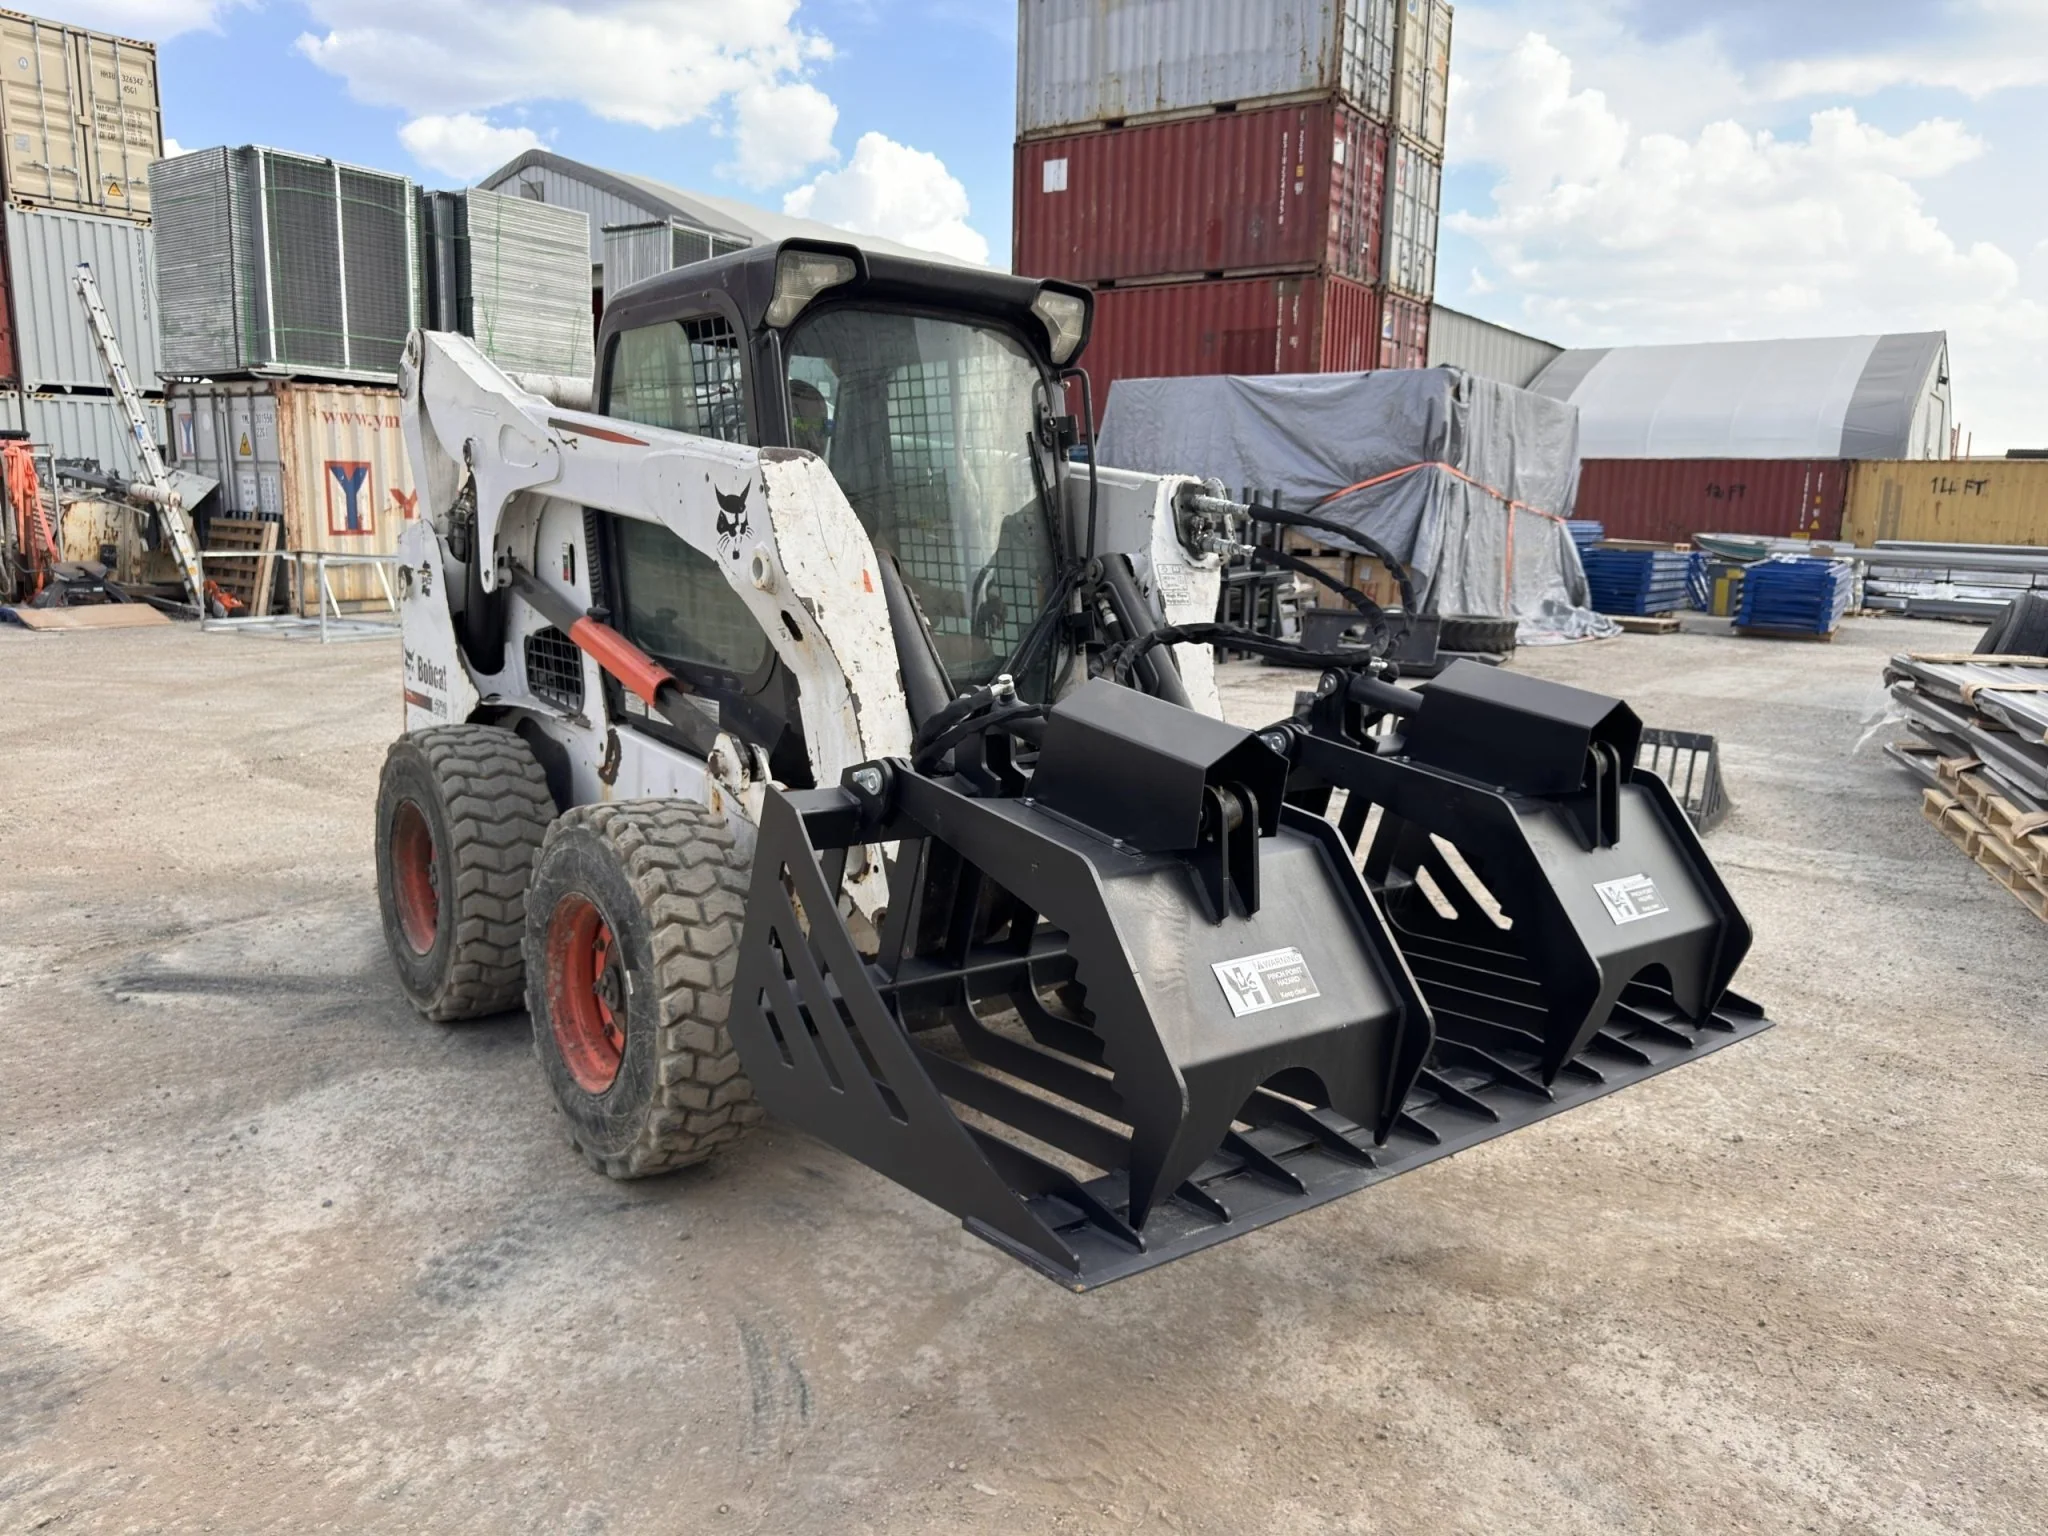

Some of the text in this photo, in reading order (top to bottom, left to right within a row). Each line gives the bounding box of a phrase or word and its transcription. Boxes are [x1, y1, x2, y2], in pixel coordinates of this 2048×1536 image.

[321, 410, 400, 432] www.ym
[1727, 483, 1747, 501] FT
[1930, 476, 1989, 496] 14 FT
[417, 655, 448, 693] Bobcat
